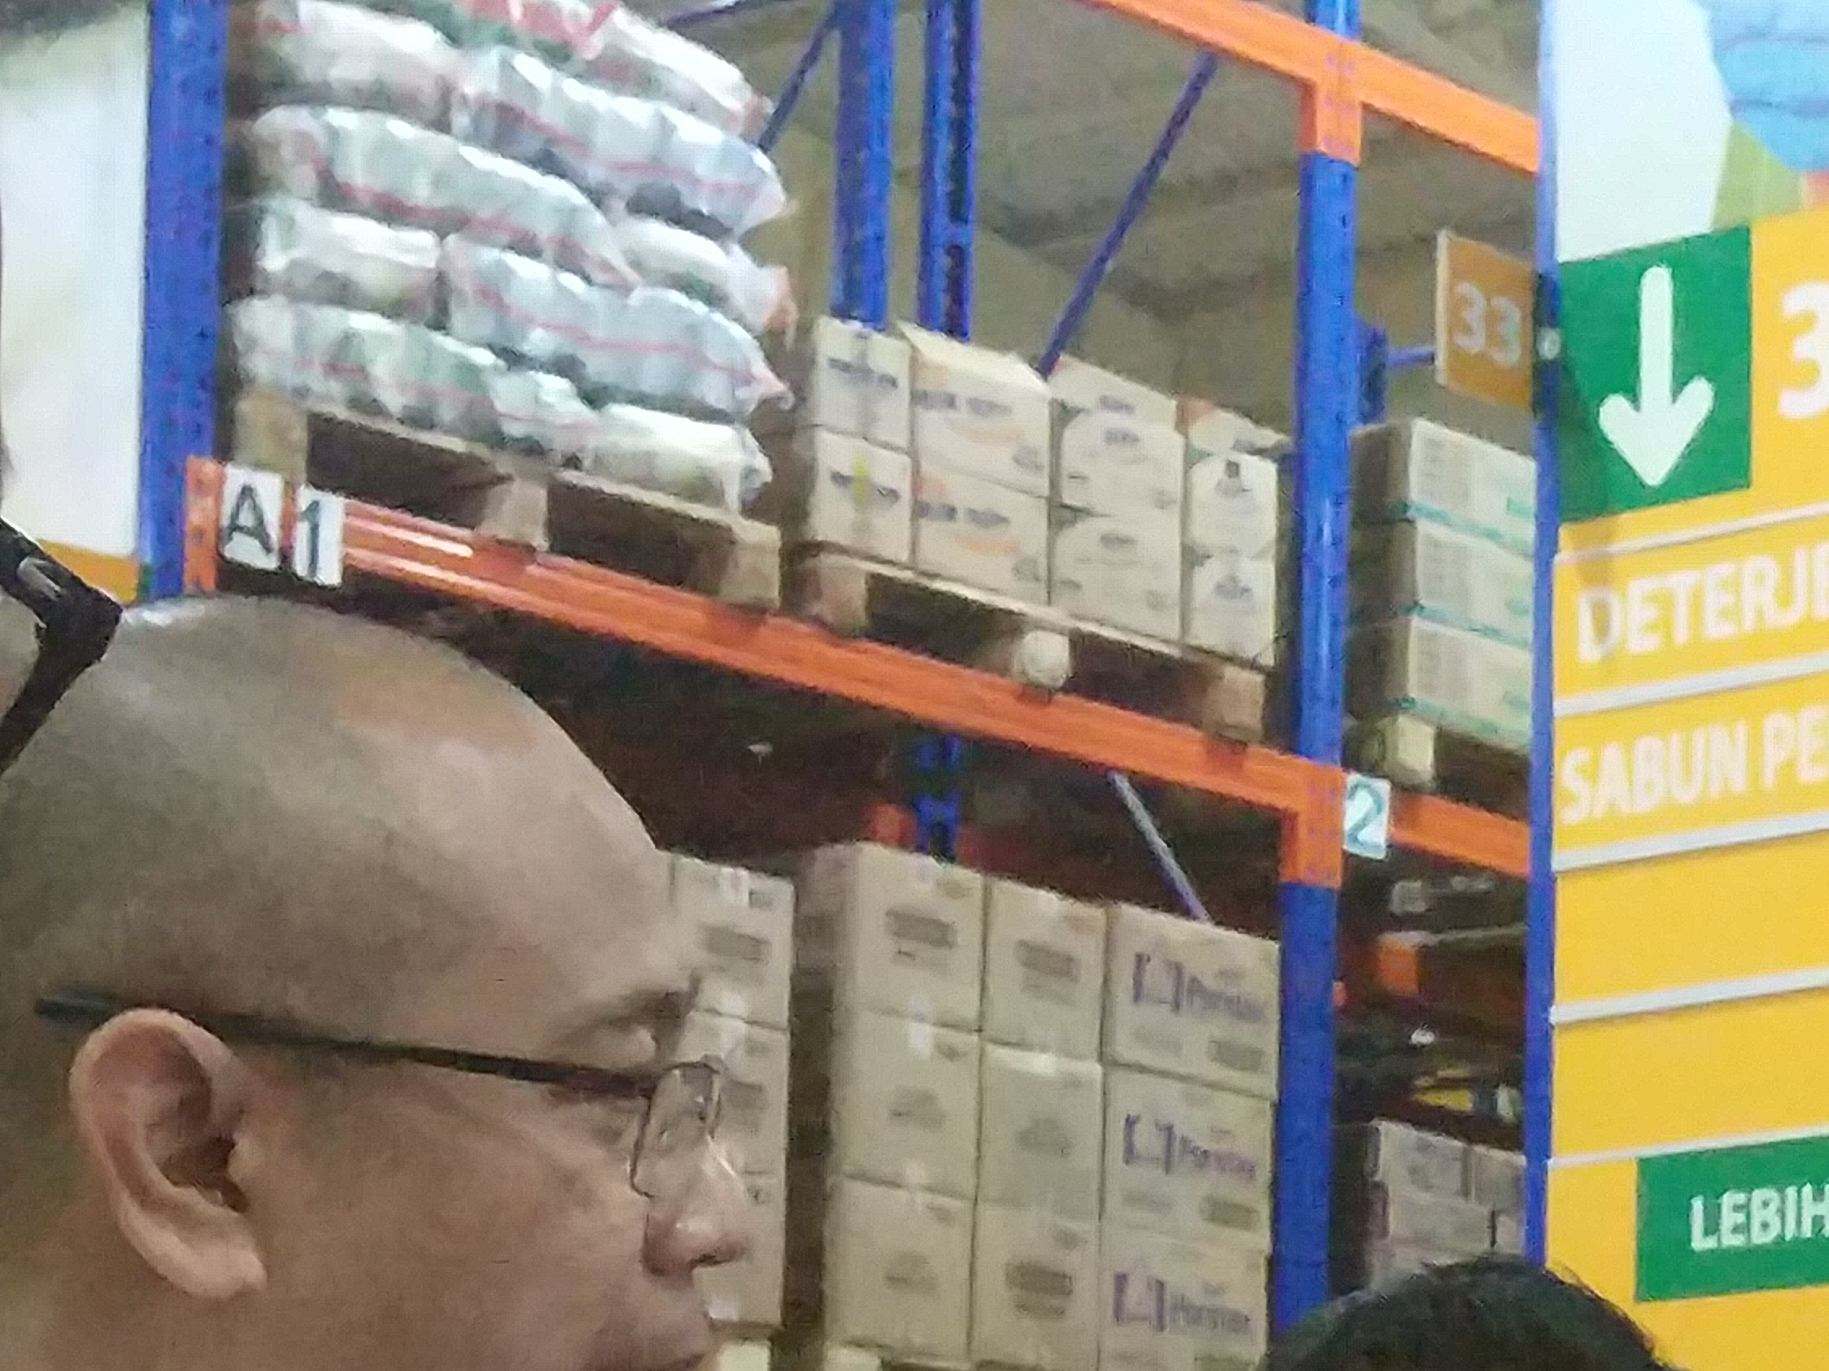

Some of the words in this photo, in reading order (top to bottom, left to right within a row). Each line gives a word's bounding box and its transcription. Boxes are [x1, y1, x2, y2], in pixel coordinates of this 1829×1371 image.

[1452, 281, 1522, 368] 33
[1560, 722, 1749, 826] SABUN
[1347, 781, 1384, 856] 2
